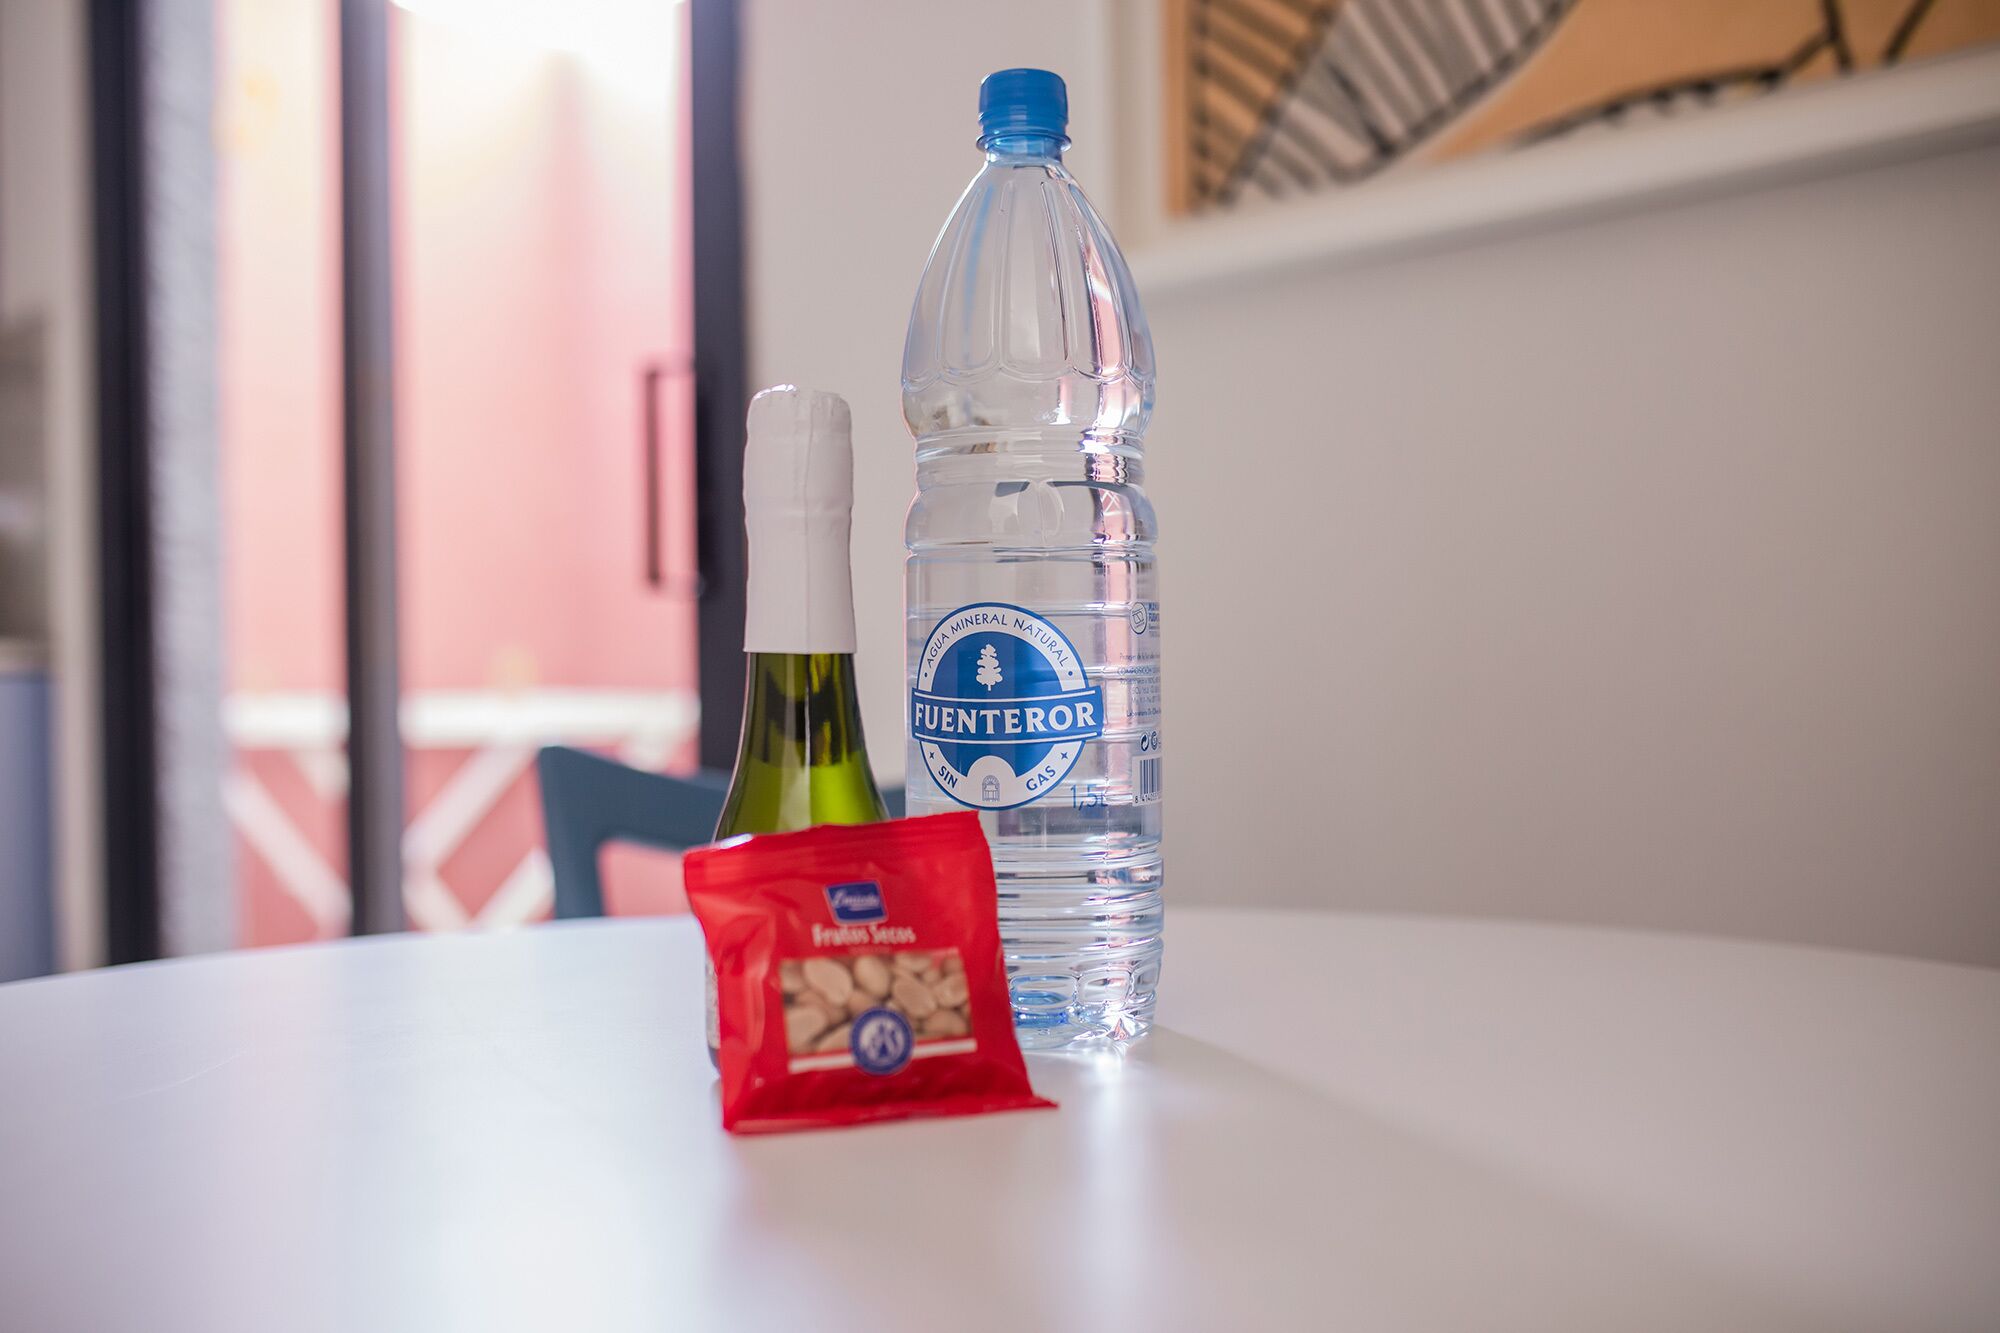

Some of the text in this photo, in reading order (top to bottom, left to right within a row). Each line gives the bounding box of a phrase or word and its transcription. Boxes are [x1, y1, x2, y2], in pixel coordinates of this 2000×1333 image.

[926, 613, 1070, 669] AGUA MINERAL NATURAL
[914, 702, 1097, 735] FUENTEROR
[938, 765, 1057, 791] SIN GAS
